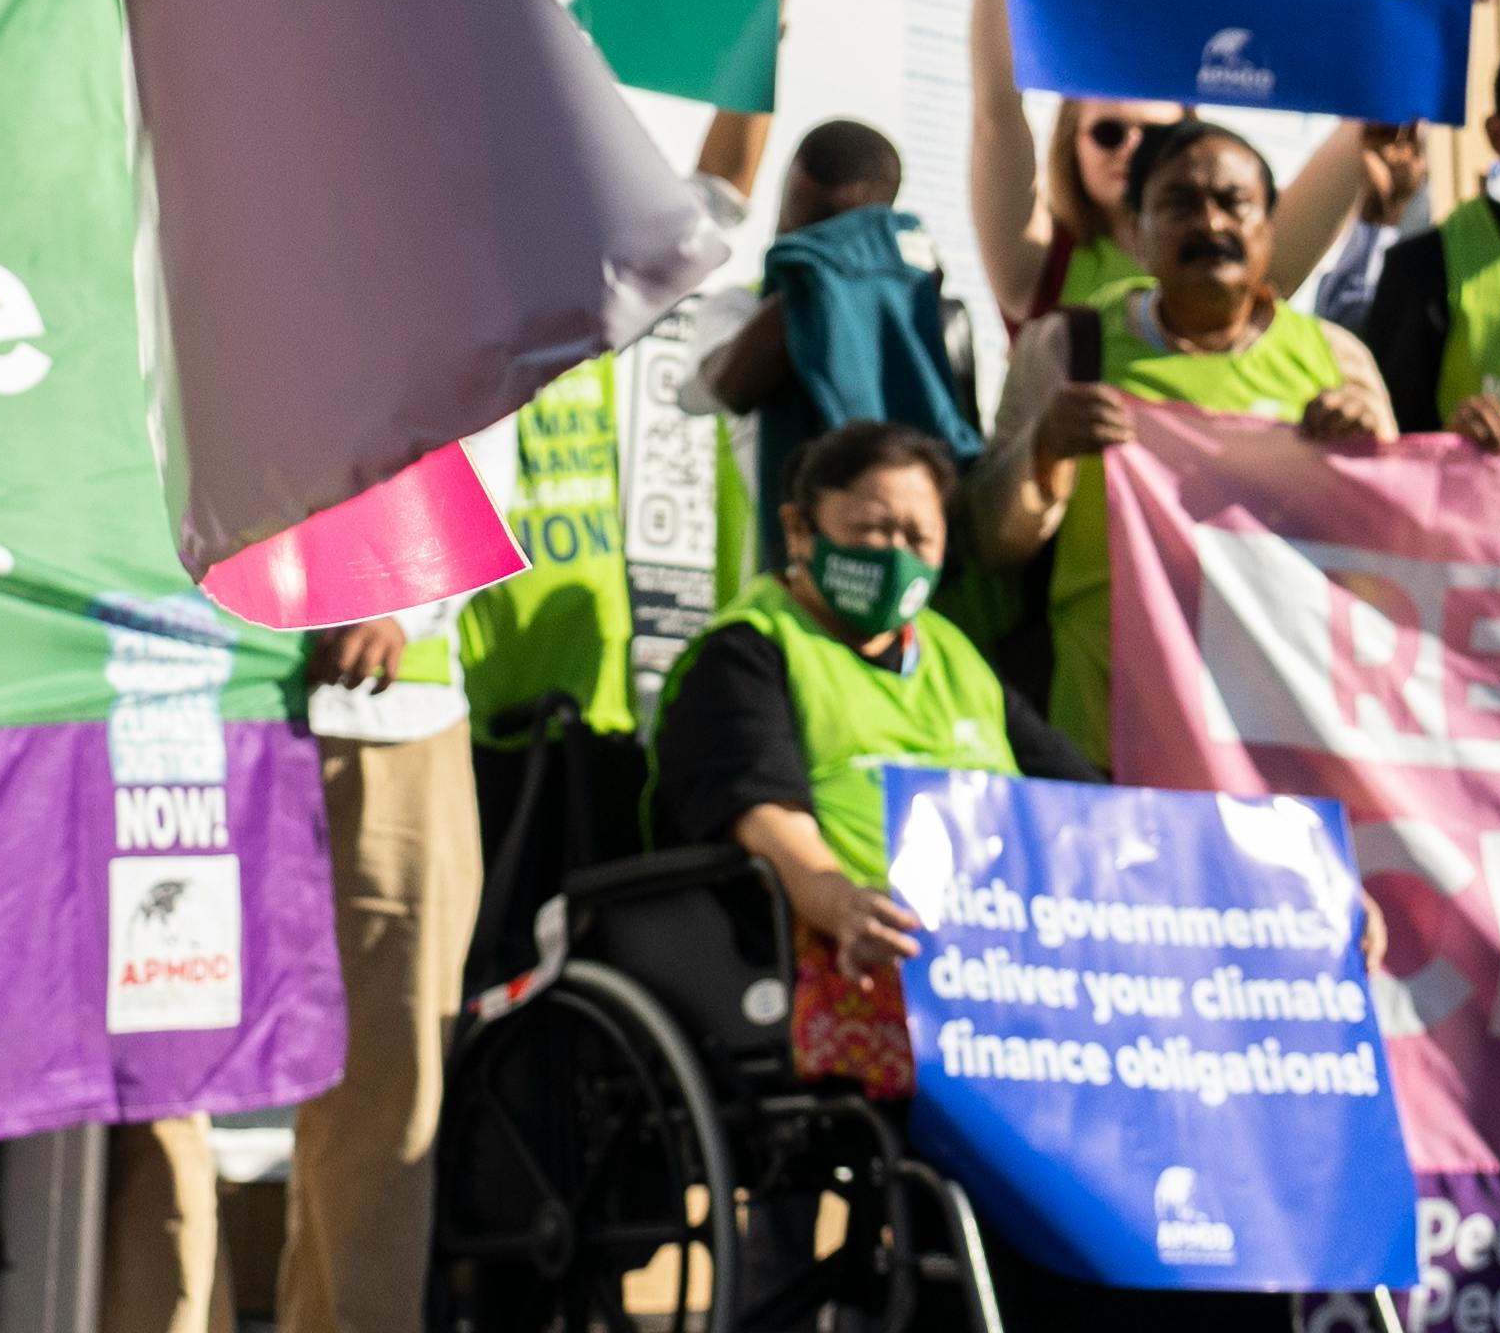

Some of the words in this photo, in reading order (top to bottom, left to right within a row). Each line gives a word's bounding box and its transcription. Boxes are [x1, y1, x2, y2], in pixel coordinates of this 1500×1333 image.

[114, 785, 230, 851] NOW!
[928, 945, 1079, 1010] deliver
[1083, 973, 1185, 1026] your
[1190, 965, 1367, 1023] climate
[938, 1020, 1112, 1087] finance
[1115, 1035, 1381, 1107] obligations!
